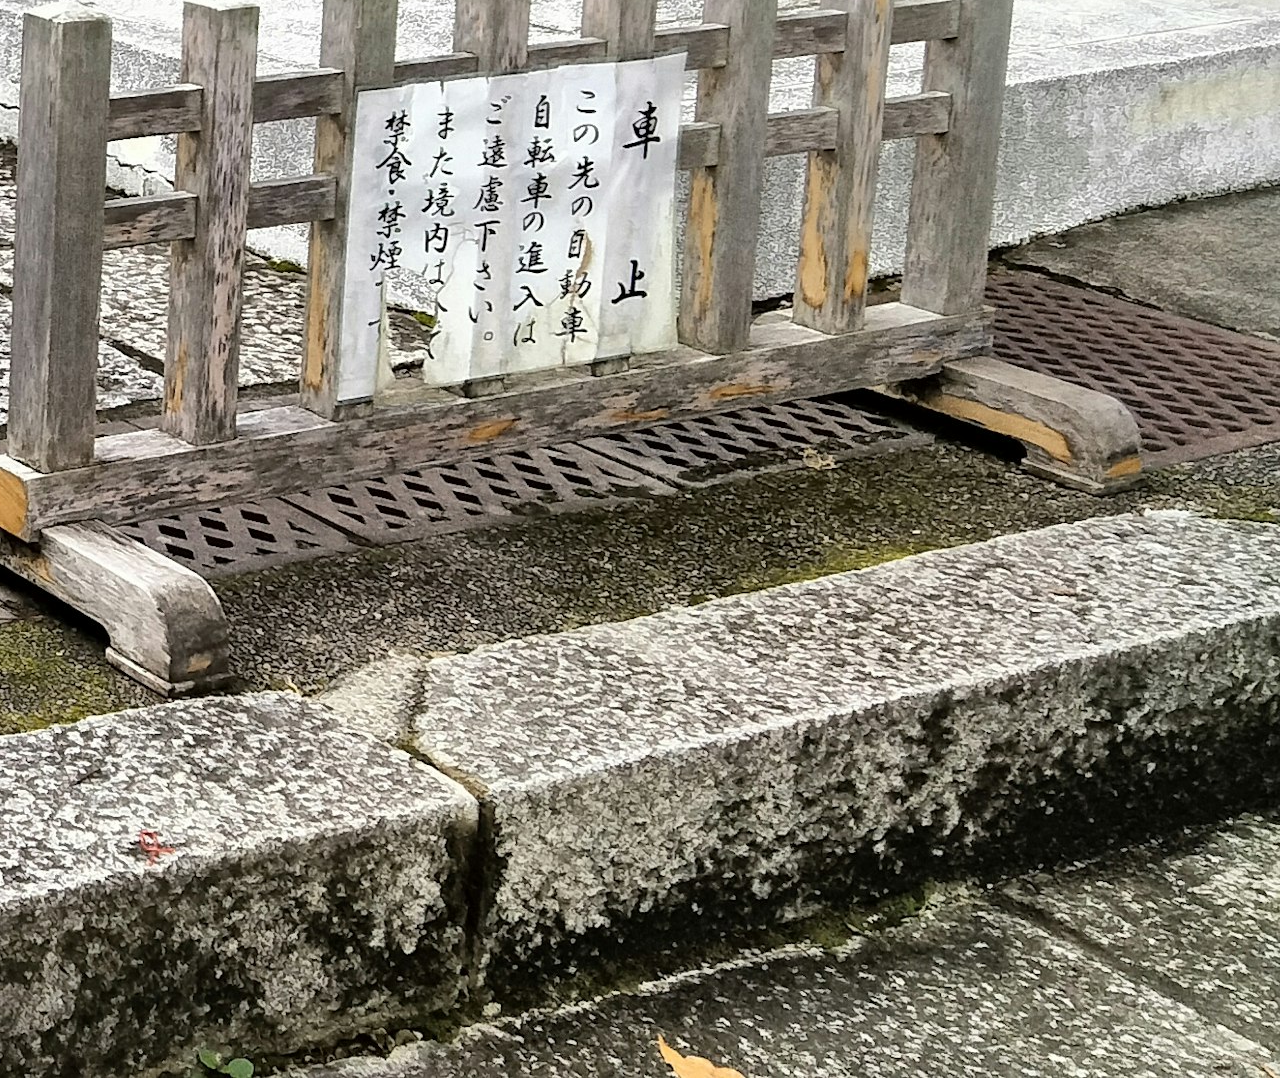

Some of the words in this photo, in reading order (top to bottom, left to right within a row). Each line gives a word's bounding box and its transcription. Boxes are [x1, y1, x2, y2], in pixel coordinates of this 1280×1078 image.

[369, 110, 412, 327] 禁食・禁煙
[420, 106, 456, 360] また境内は
[467, 95, 512, 342] ご遠慮下さい。
[512, 95, 556, 347] 自転車の進入は
[553, 90, 601, 343] この先の自動車
